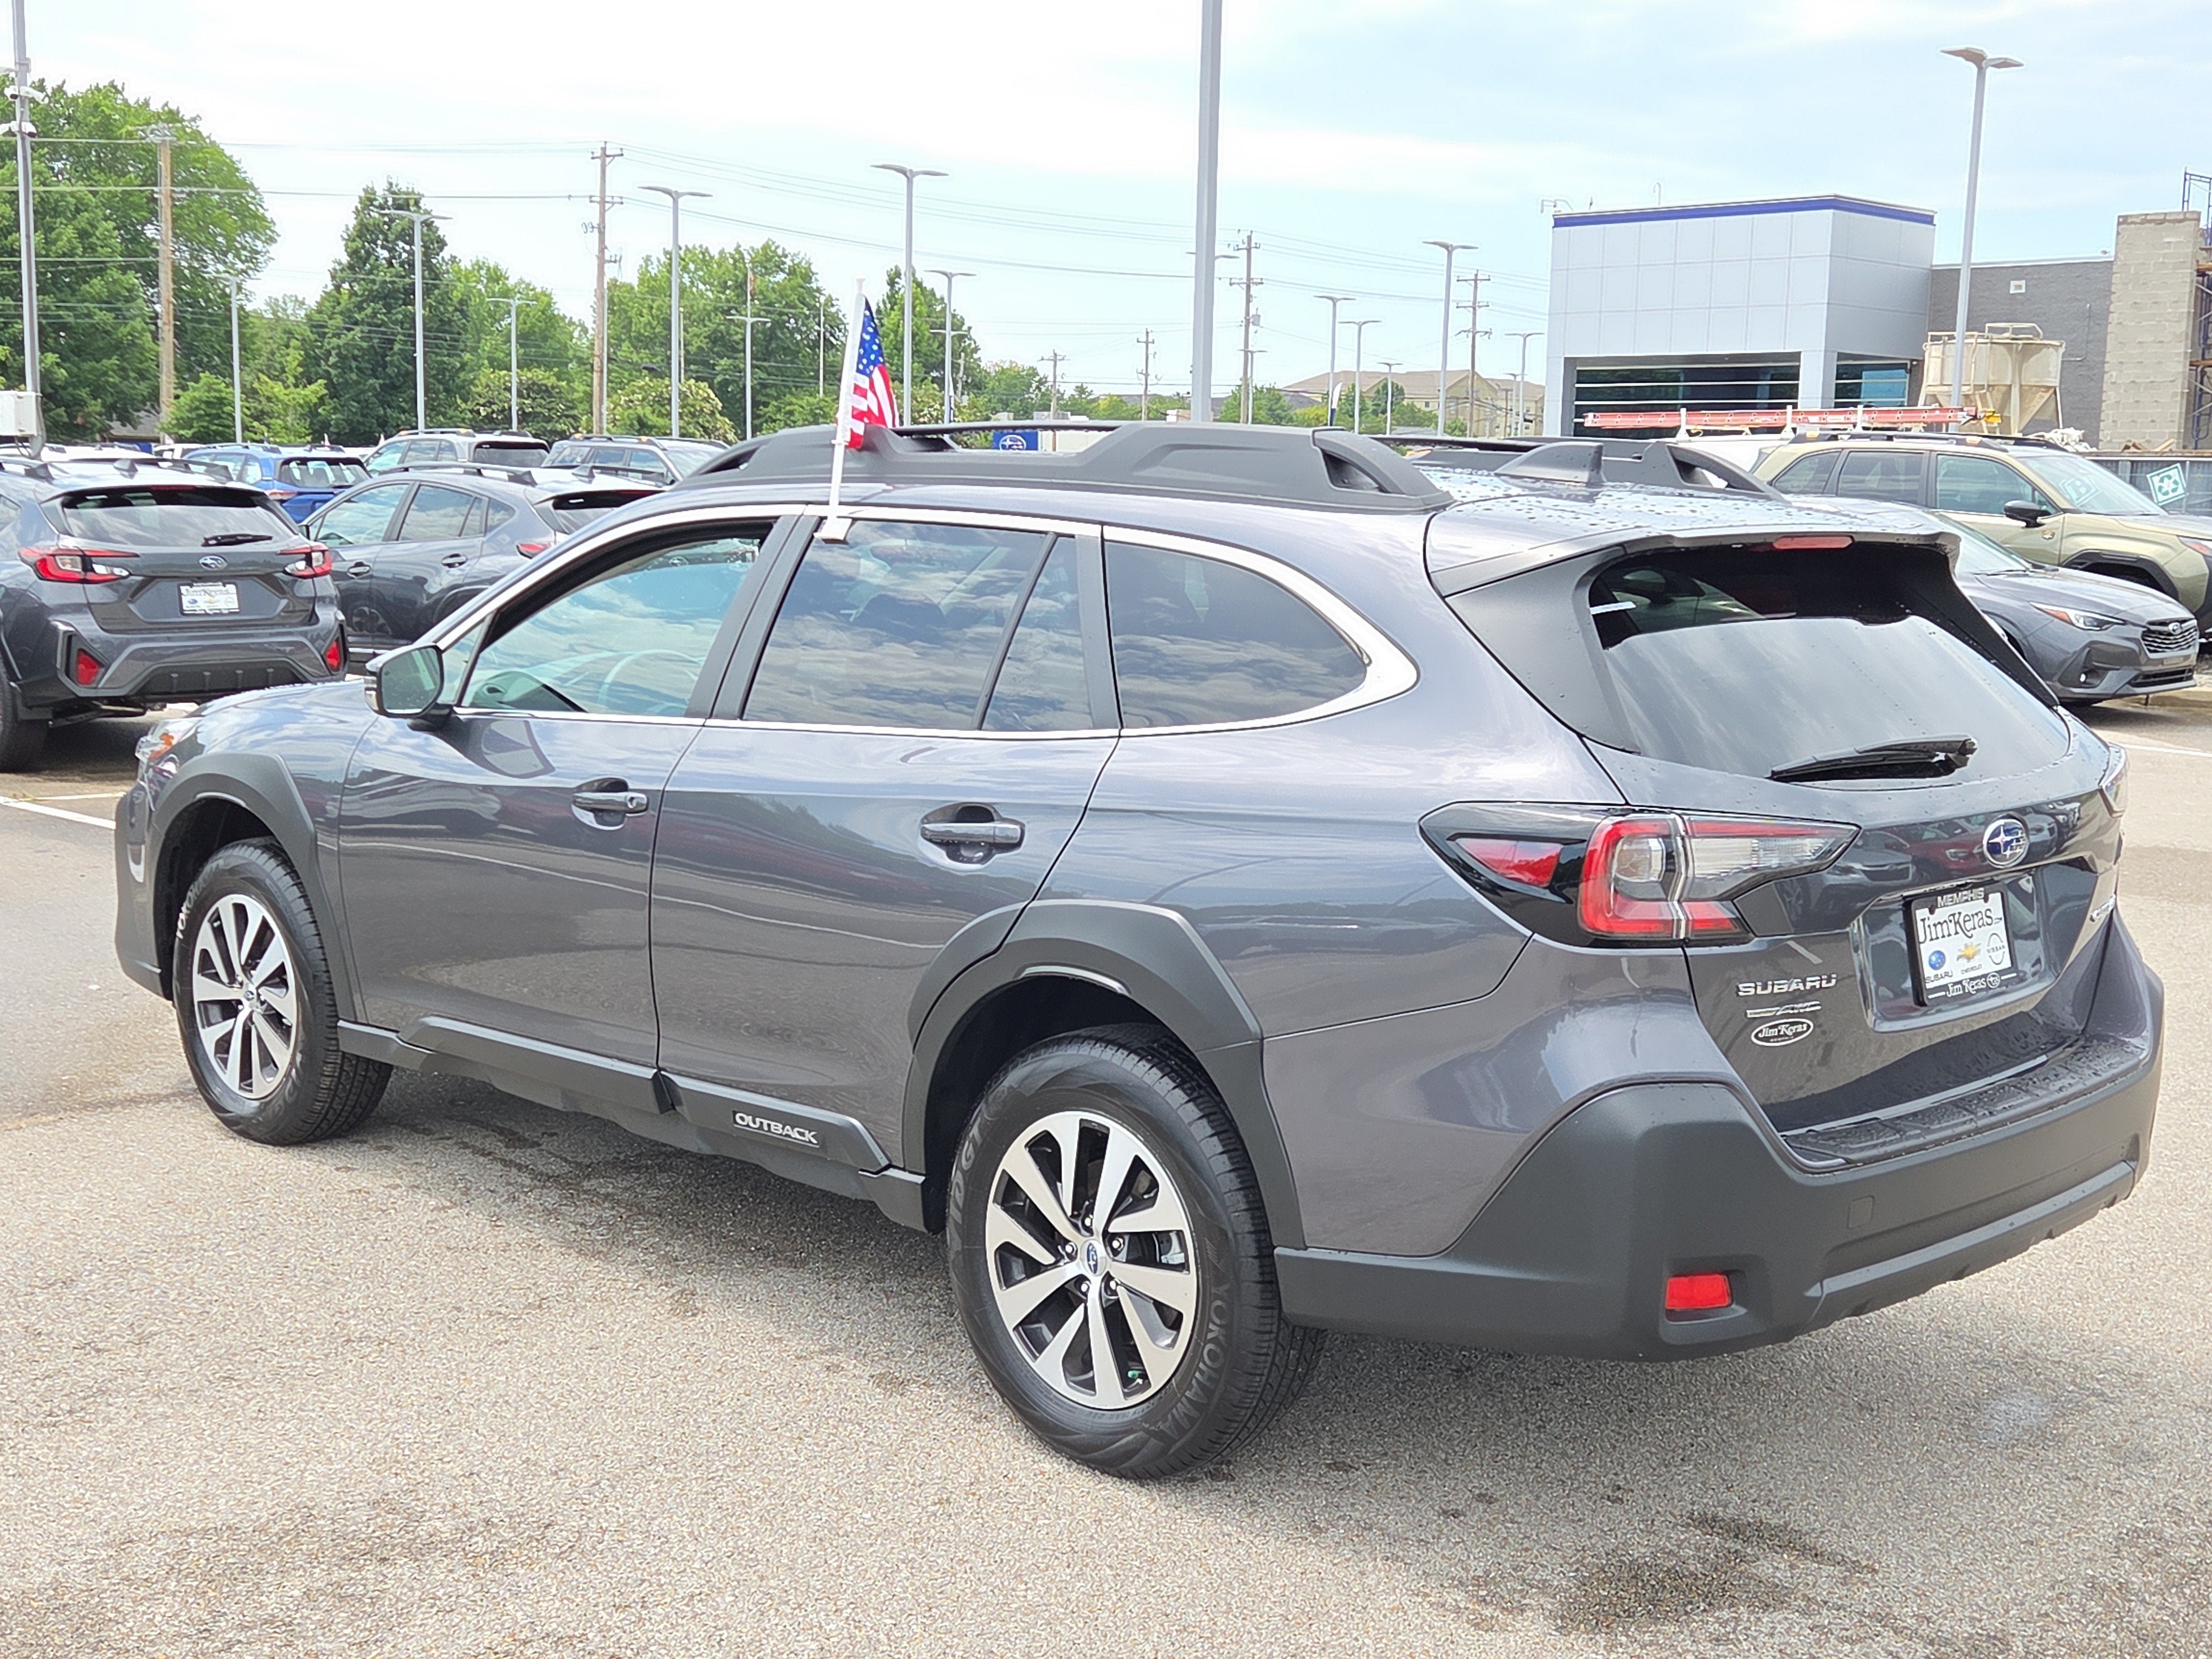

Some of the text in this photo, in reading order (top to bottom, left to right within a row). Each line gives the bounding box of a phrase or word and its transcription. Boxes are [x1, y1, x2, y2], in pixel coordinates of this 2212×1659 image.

[1937, 888, 1985, 908] MEMPHIS
[1919, 908, 1994, 944] Jim Keras
[1737, 974, 1837, 996] SUBARU
[1925, 970, 1953, 983] SUBARU
[1946, 977, 1986, 997] Jim Keras
[1758, 1023, 1808, 1038] Jim Keras
[735, 1113, 818, 1144] OUTBACK
[1159, 1282, 1231, 1440] YOKOHAMA
